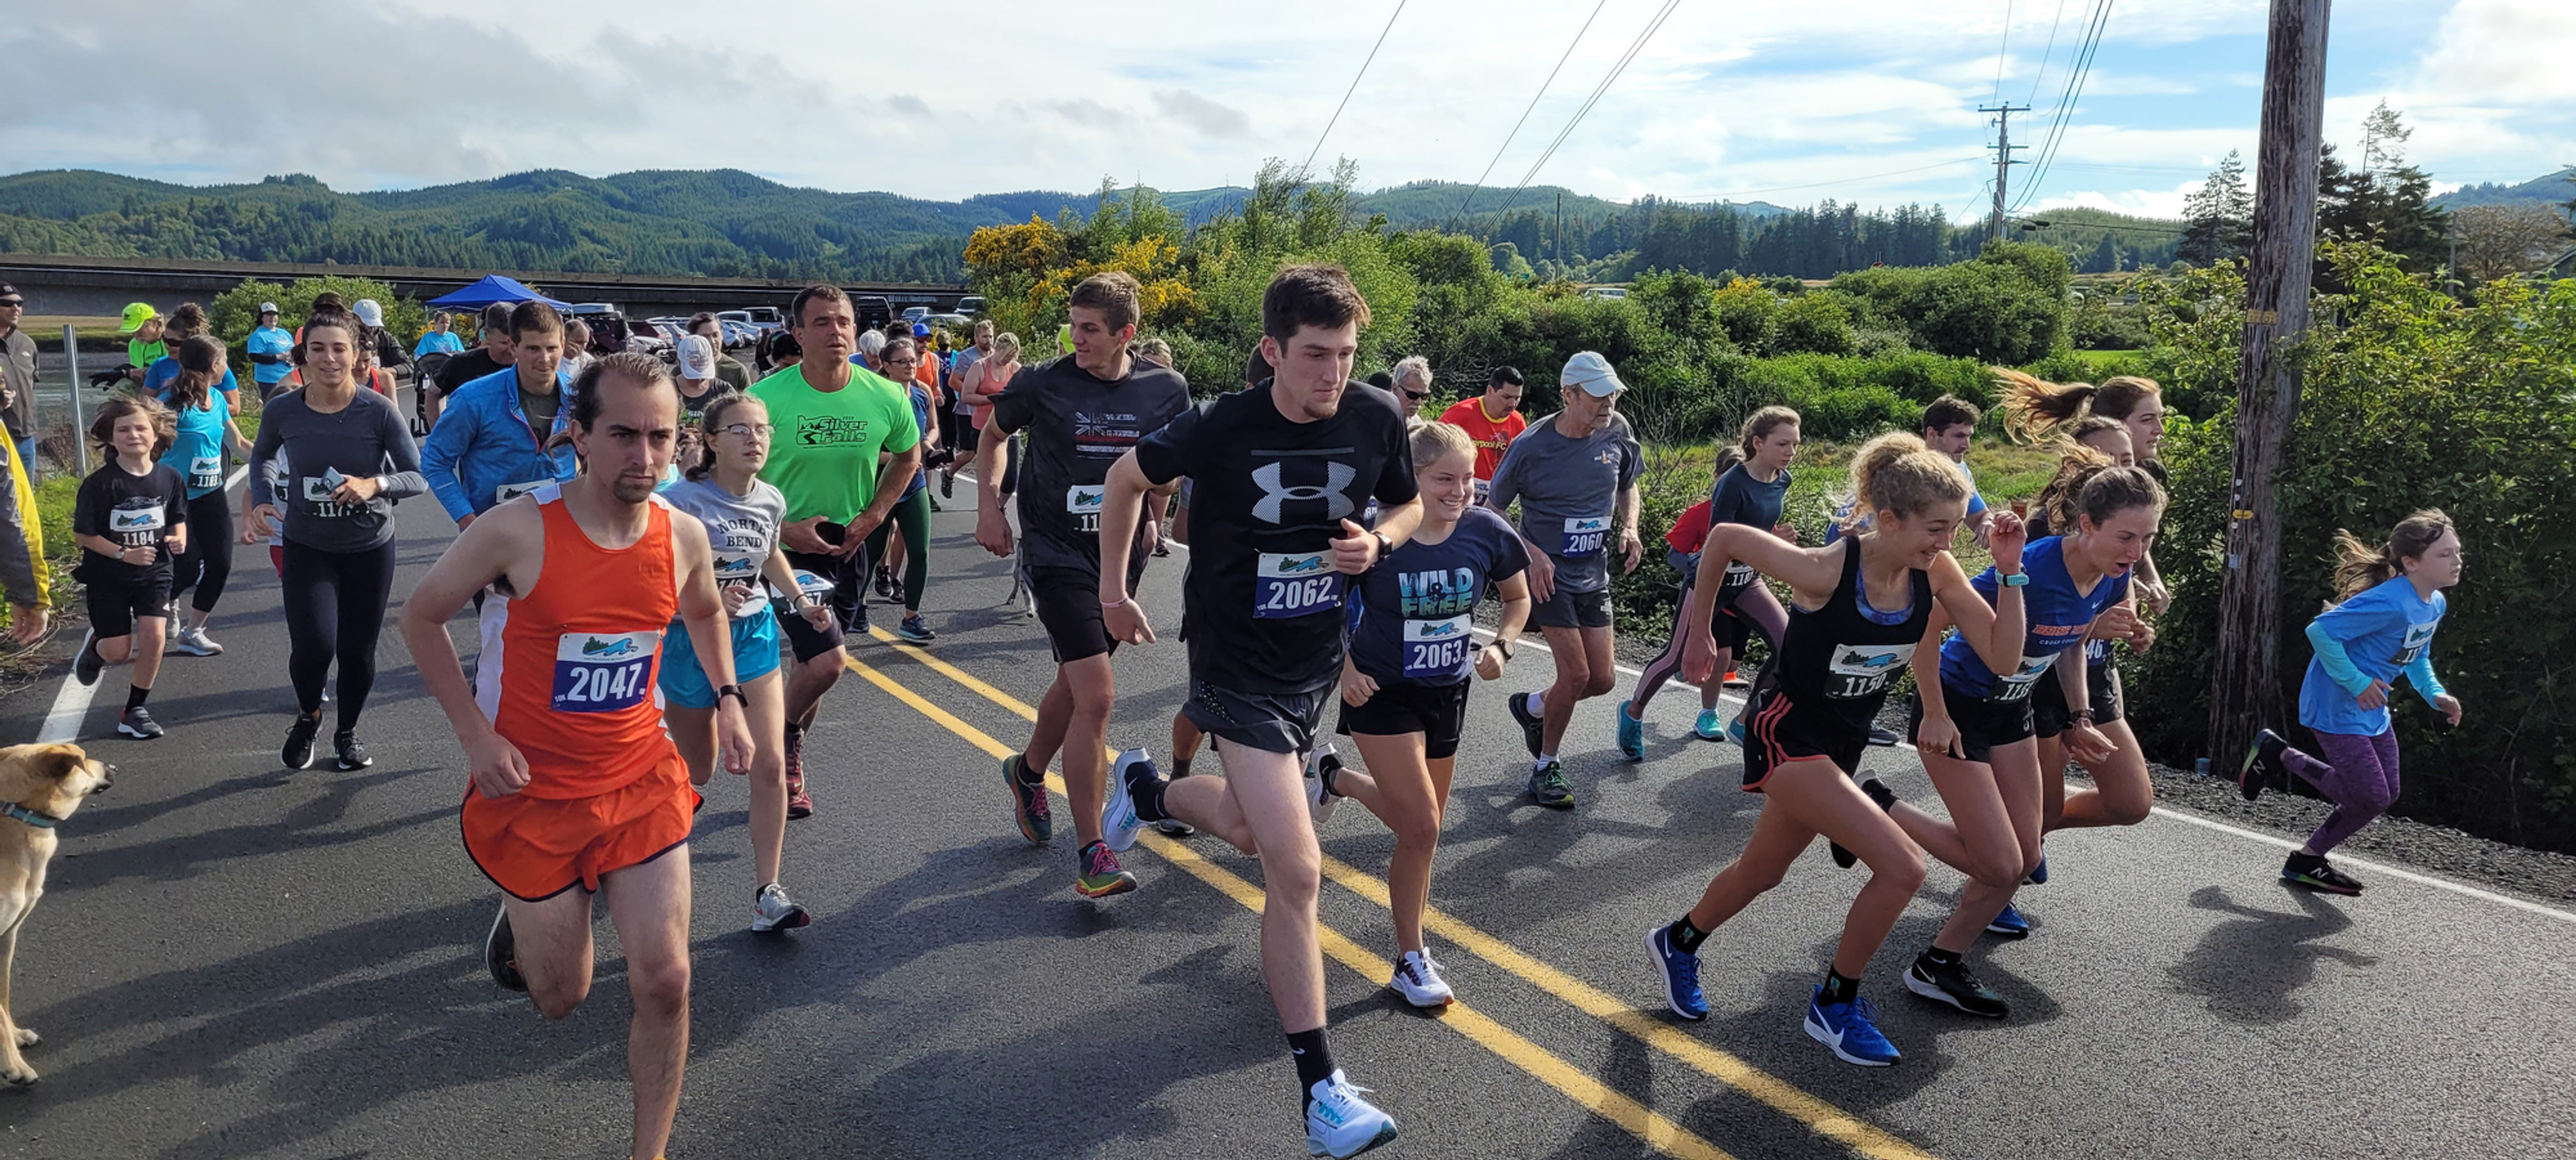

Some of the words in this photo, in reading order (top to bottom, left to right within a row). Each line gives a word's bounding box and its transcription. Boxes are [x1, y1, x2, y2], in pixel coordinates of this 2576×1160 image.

[819, 419, 868, 431] Silver
[820, 431, 867, 443] Falls
[1496, 441, 1506, 450] FC
[1081, 514, 1099, 531] 11
[123, 531, 155, 546] 1184
[726, 536, 763, 548] BEND
[1569, 533, 1603, 552] 2060
[1399, 567, 1473, 597] WILD
[1268, 576, 1333, 609] 2062
[1401, 591, 1472, 617] FREE
[1413, 639, 1462, 669] 2063
[2086, 639, 2103, 659] 46
[567, 662, 642, 702] 2047
[1842, 673, 1887, 696] 1150
